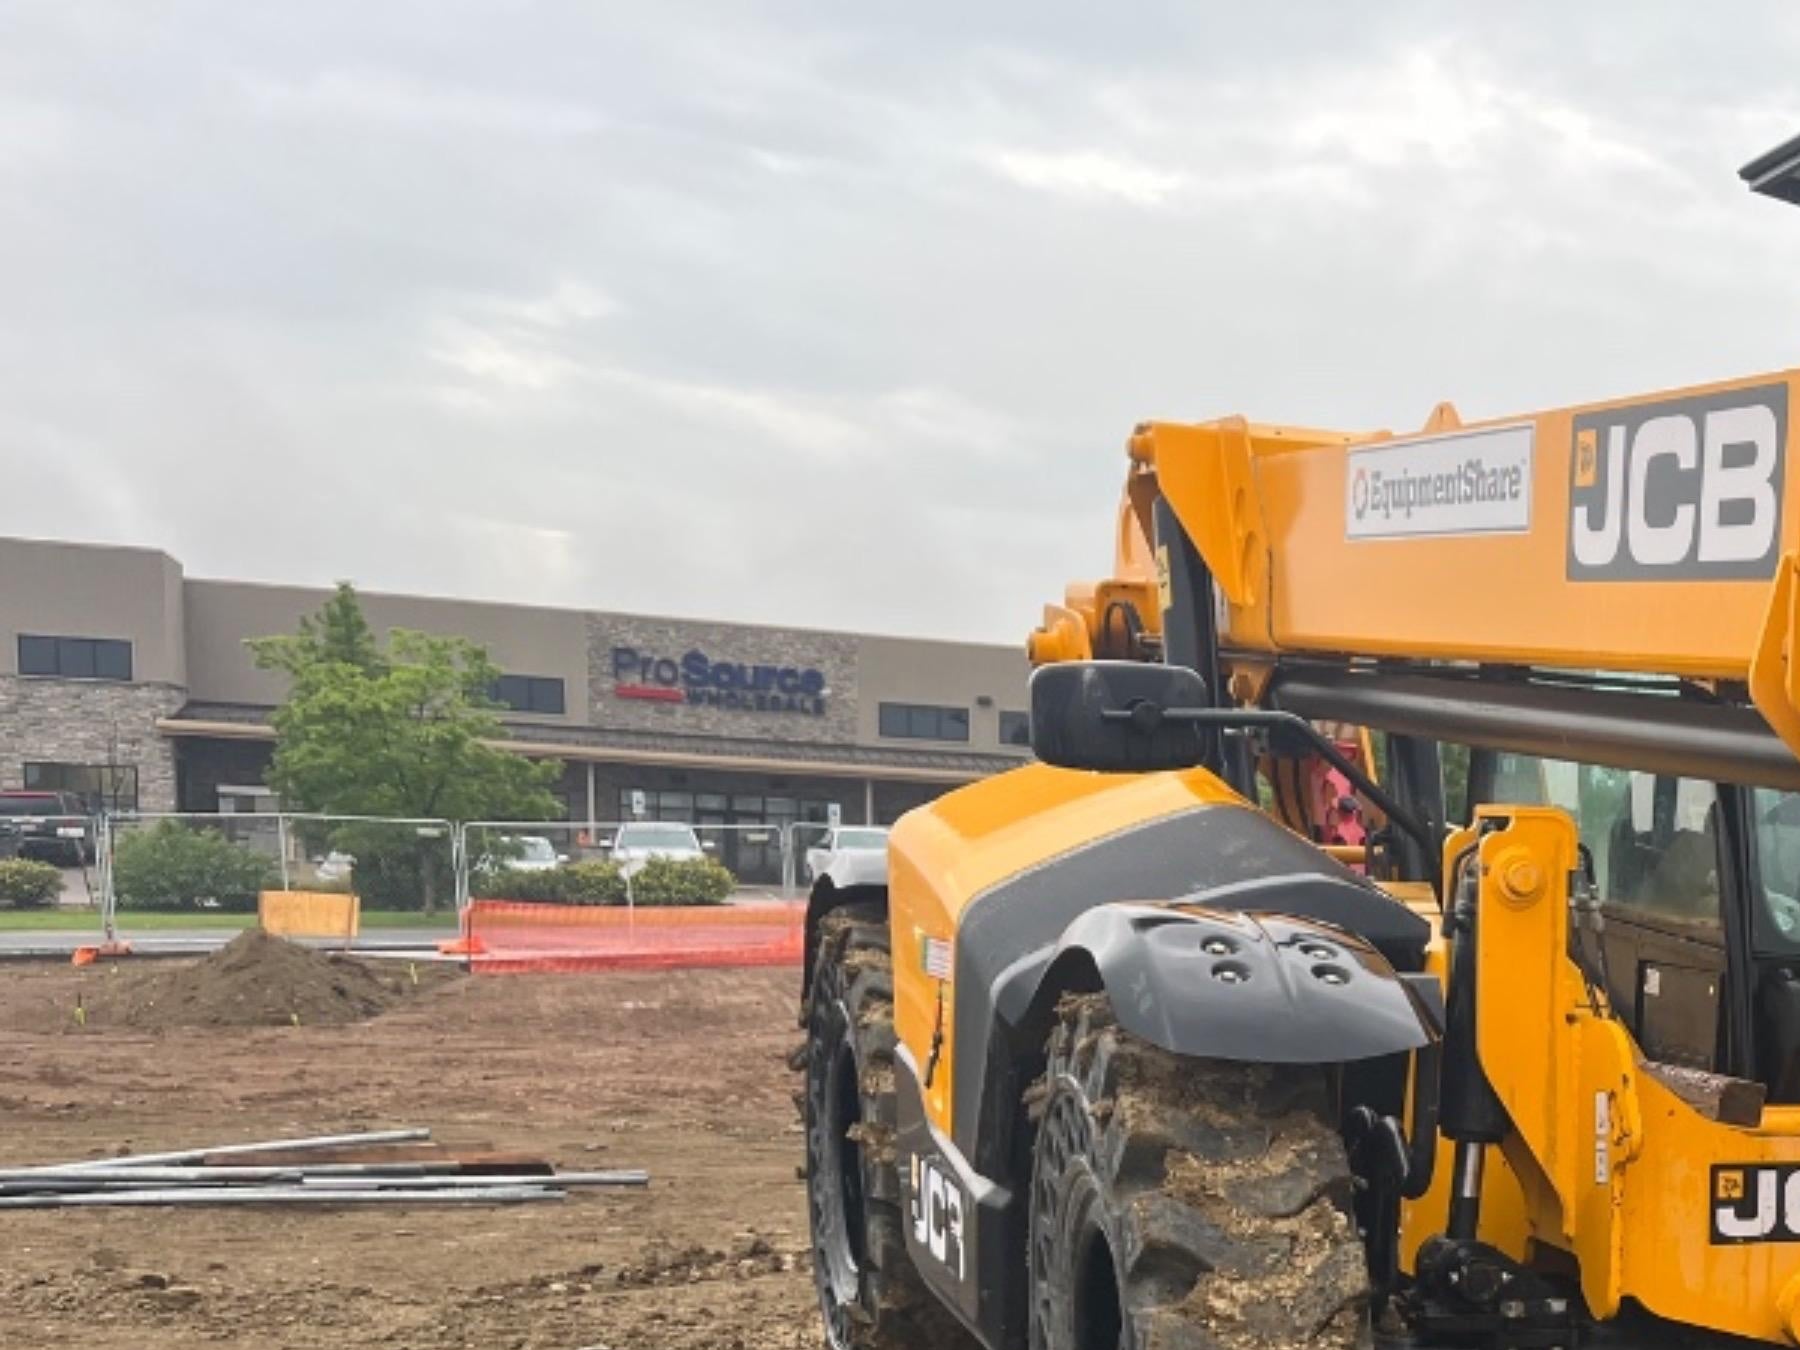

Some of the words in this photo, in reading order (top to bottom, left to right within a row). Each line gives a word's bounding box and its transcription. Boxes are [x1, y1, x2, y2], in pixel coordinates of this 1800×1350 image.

[1371, 458, 1522, 520] EquipmentShare
[1573, 404, 1777, 566] JCB
[611, 647, 826, 695] ProSource
